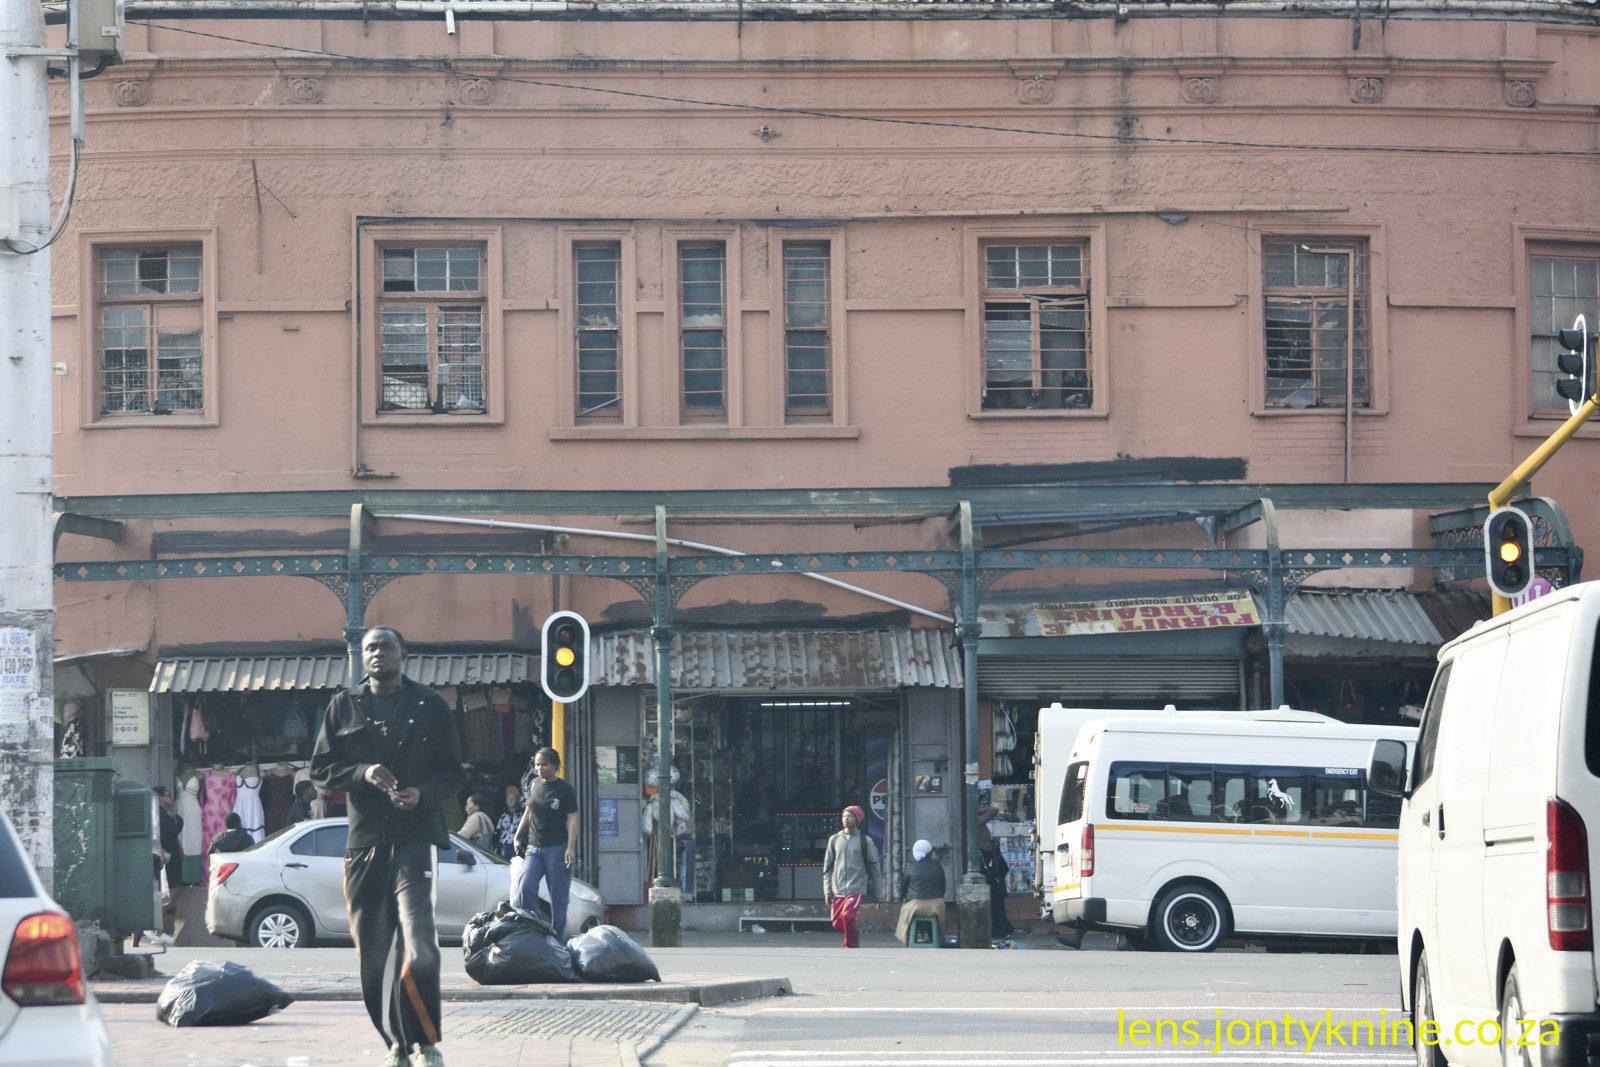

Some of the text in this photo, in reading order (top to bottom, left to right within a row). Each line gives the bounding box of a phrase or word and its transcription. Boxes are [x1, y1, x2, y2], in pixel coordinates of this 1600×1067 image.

[1105, 598, 1168, 608] HOUSEHOLD
[1174, 595, 1219, 604] QUALITY
[3, 675, 28, 684] RATE
